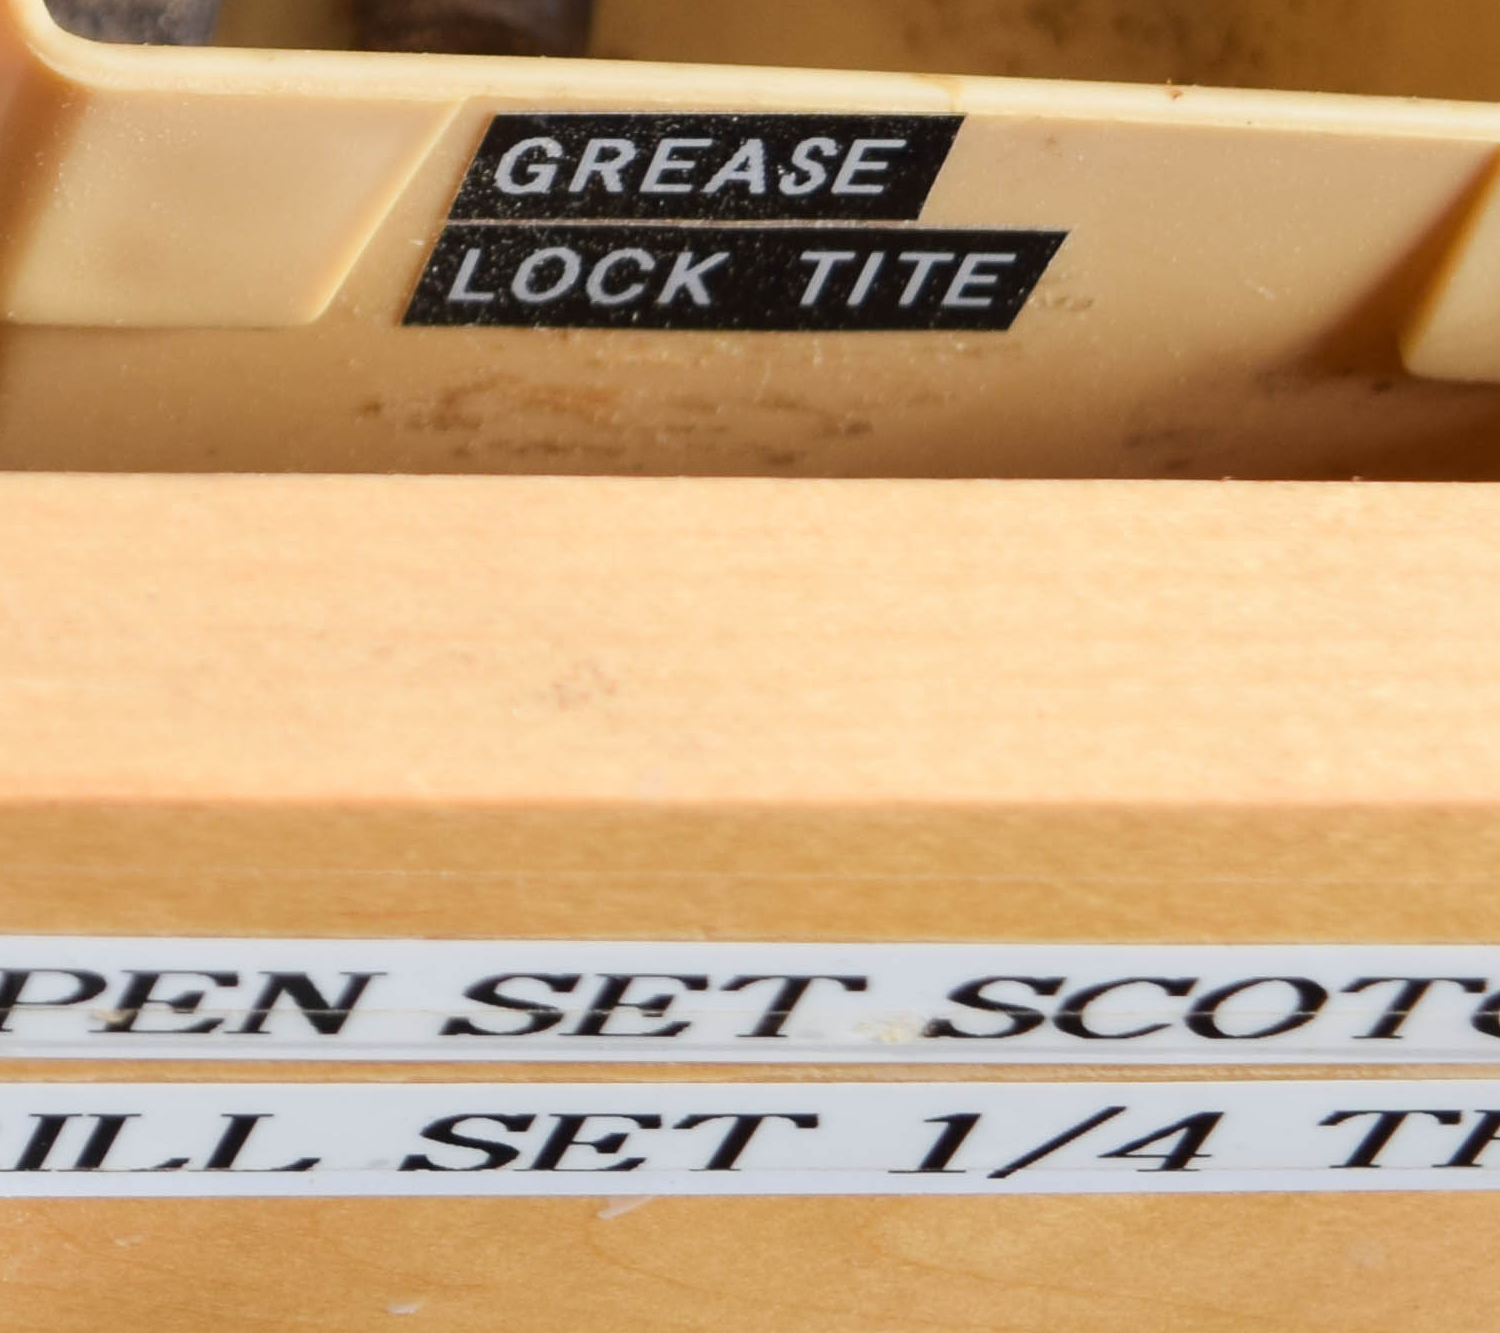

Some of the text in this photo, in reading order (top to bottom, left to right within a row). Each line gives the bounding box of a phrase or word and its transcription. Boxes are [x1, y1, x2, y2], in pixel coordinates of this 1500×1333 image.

[493, 137, 908, 195] GREASE
[448, 247, 1016, 305] LOCK TITE
[438, 971, 871, 1039] SET
[397, 1112, 820, 1173] SET
[888, 1106, 1224, 1178] 1/4
